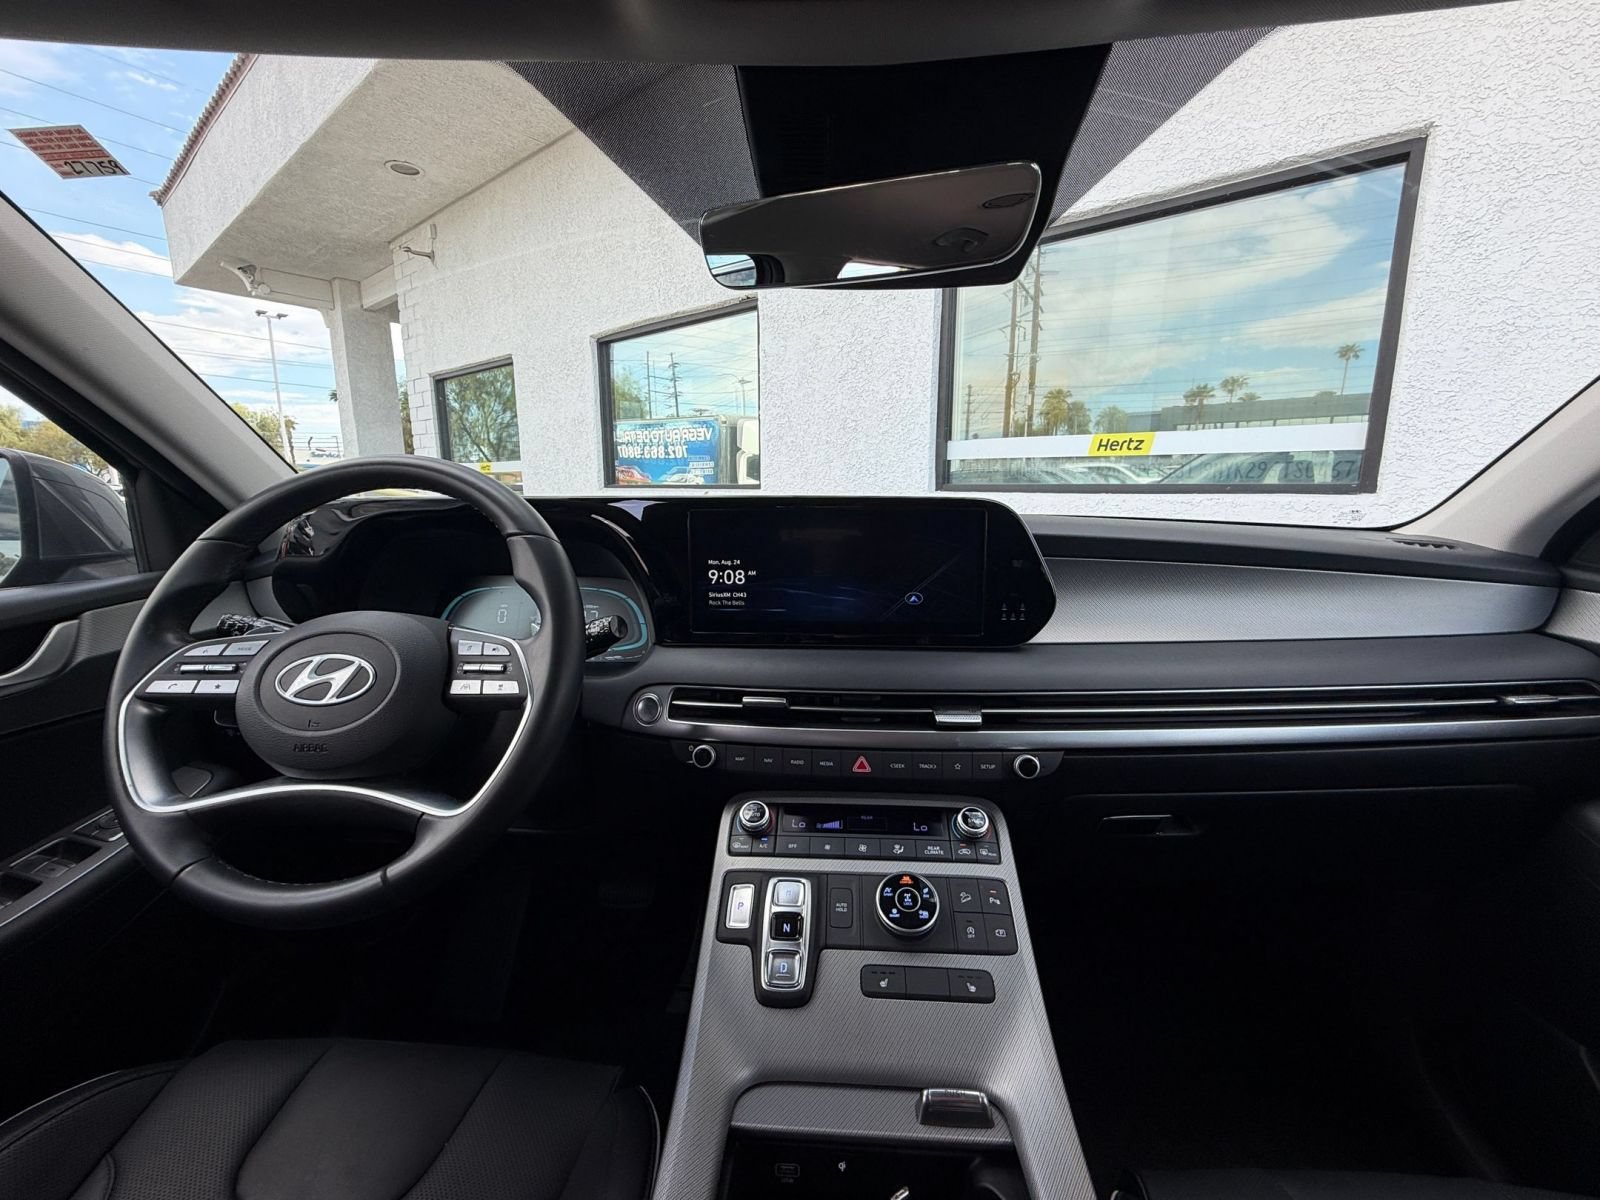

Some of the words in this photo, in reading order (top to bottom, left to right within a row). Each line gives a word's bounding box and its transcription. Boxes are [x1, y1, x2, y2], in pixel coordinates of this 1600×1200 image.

[64, 159, 125, 175] 27759
[1096, 437, 1144, 451] Hertz
[708, 569, 746, 585] 9:08
[497, 608, 508, 624] 0
[291, 742, 329, 753] AIRBAG
[737, 902, 745, 910] P
[782, 923, 791, 933] N
[780, 962, 788, 973] D
